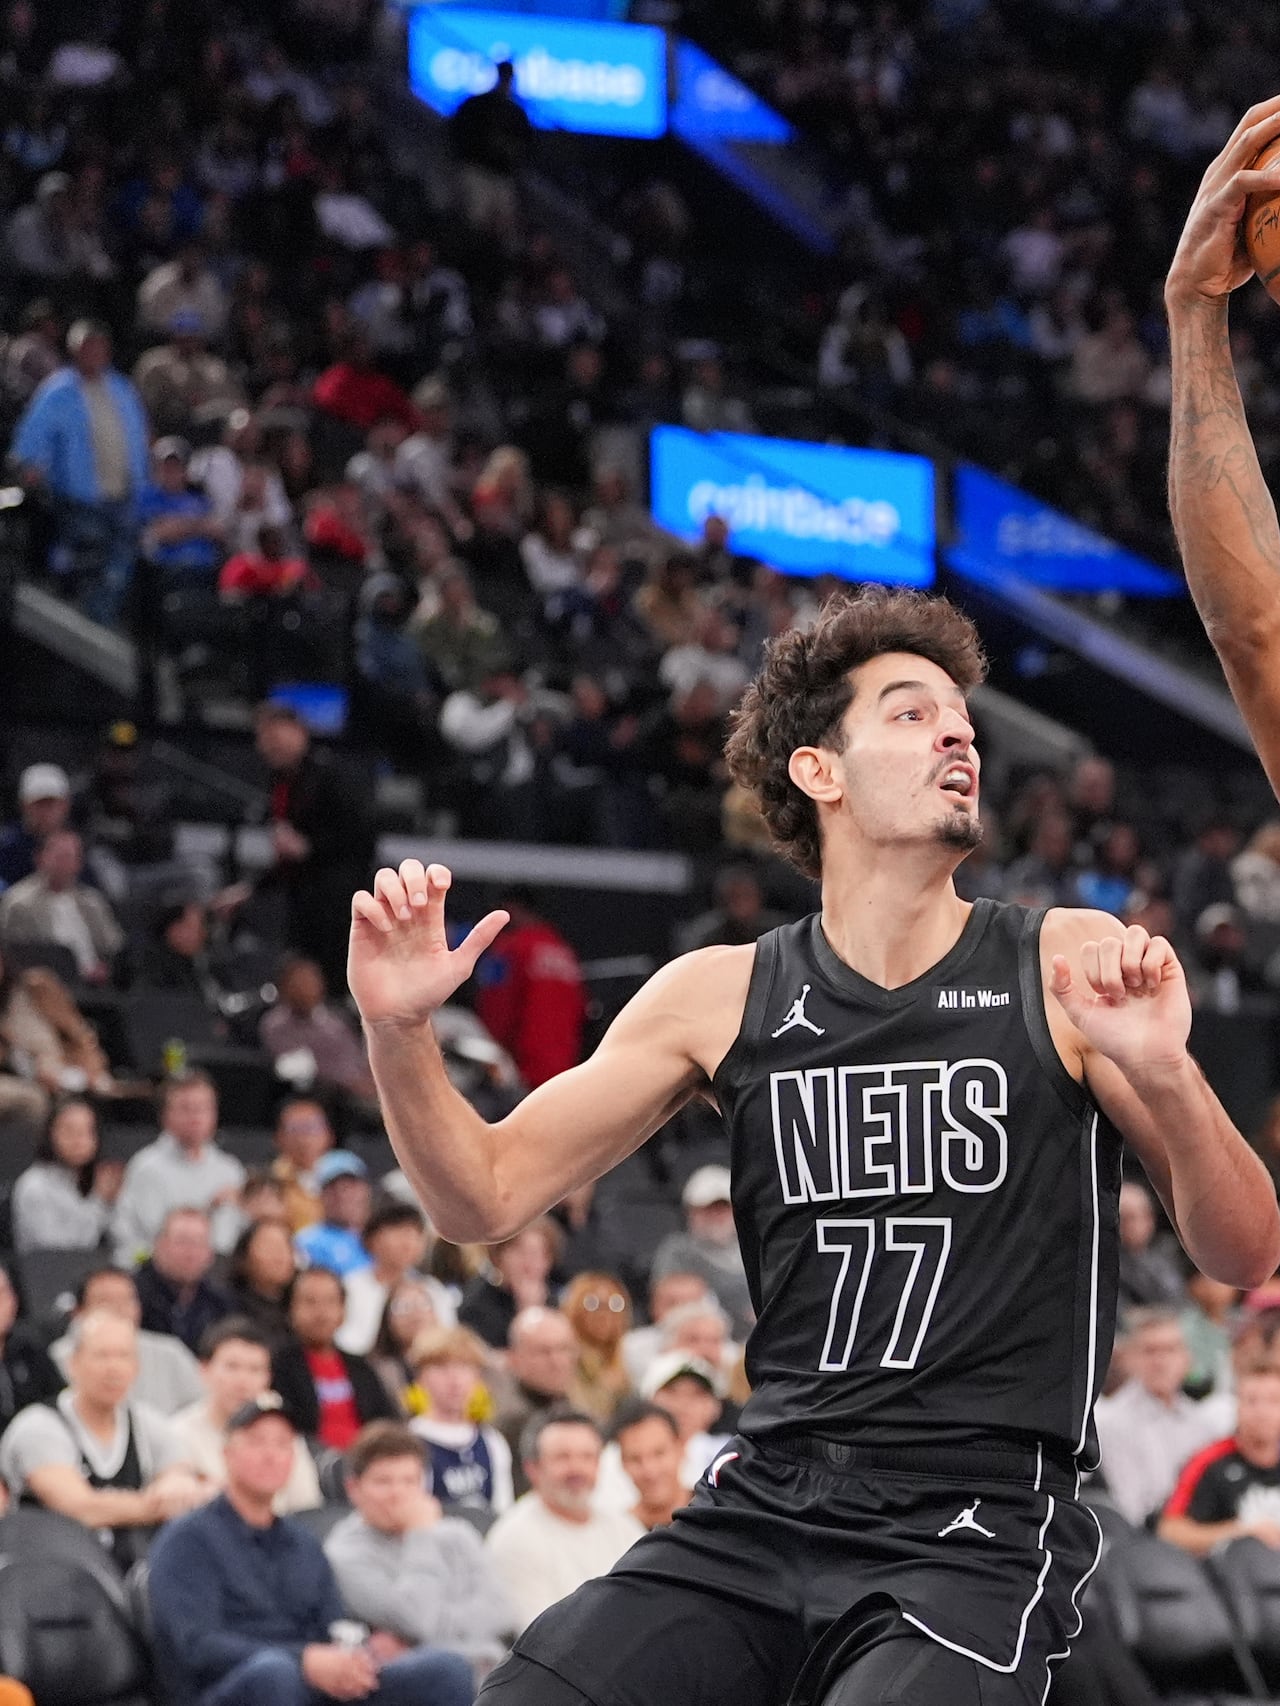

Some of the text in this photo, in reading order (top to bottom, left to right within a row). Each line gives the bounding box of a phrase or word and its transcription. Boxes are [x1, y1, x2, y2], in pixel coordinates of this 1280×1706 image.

[938, 990, 1010, 1009] All In Won
[770, 1058, 1008, 1205] NETS
[816, 1217, 952, 1371] 77
